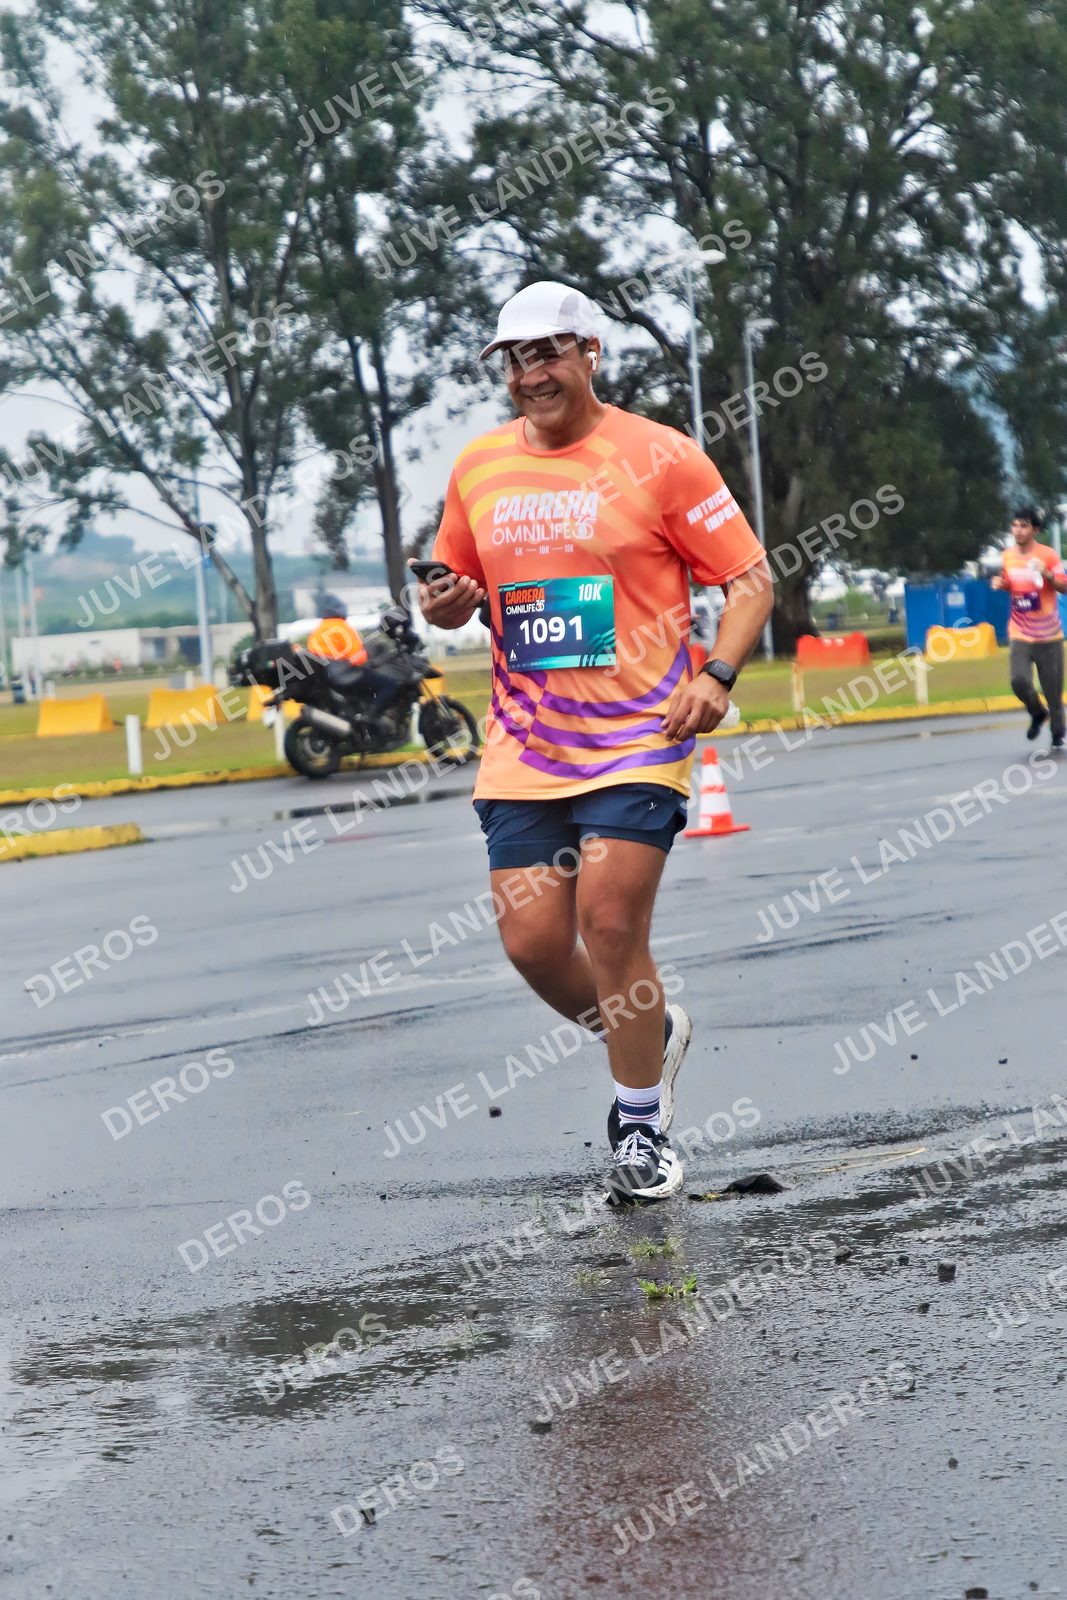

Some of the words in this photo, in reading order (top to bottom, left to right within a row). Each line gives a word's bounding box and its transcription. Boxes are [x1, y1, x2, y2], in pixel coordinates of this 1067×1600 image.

[494, 489, 599, 525] CARRERA
[492, 522, 571, 545] OMNILIFE
[505, 587, 545, 605] CARRERA
[578, 583, 603, 601] 10K
[506, 603, 535, 615] OMNILIFE
[520, 615, 582, 645] 1091
